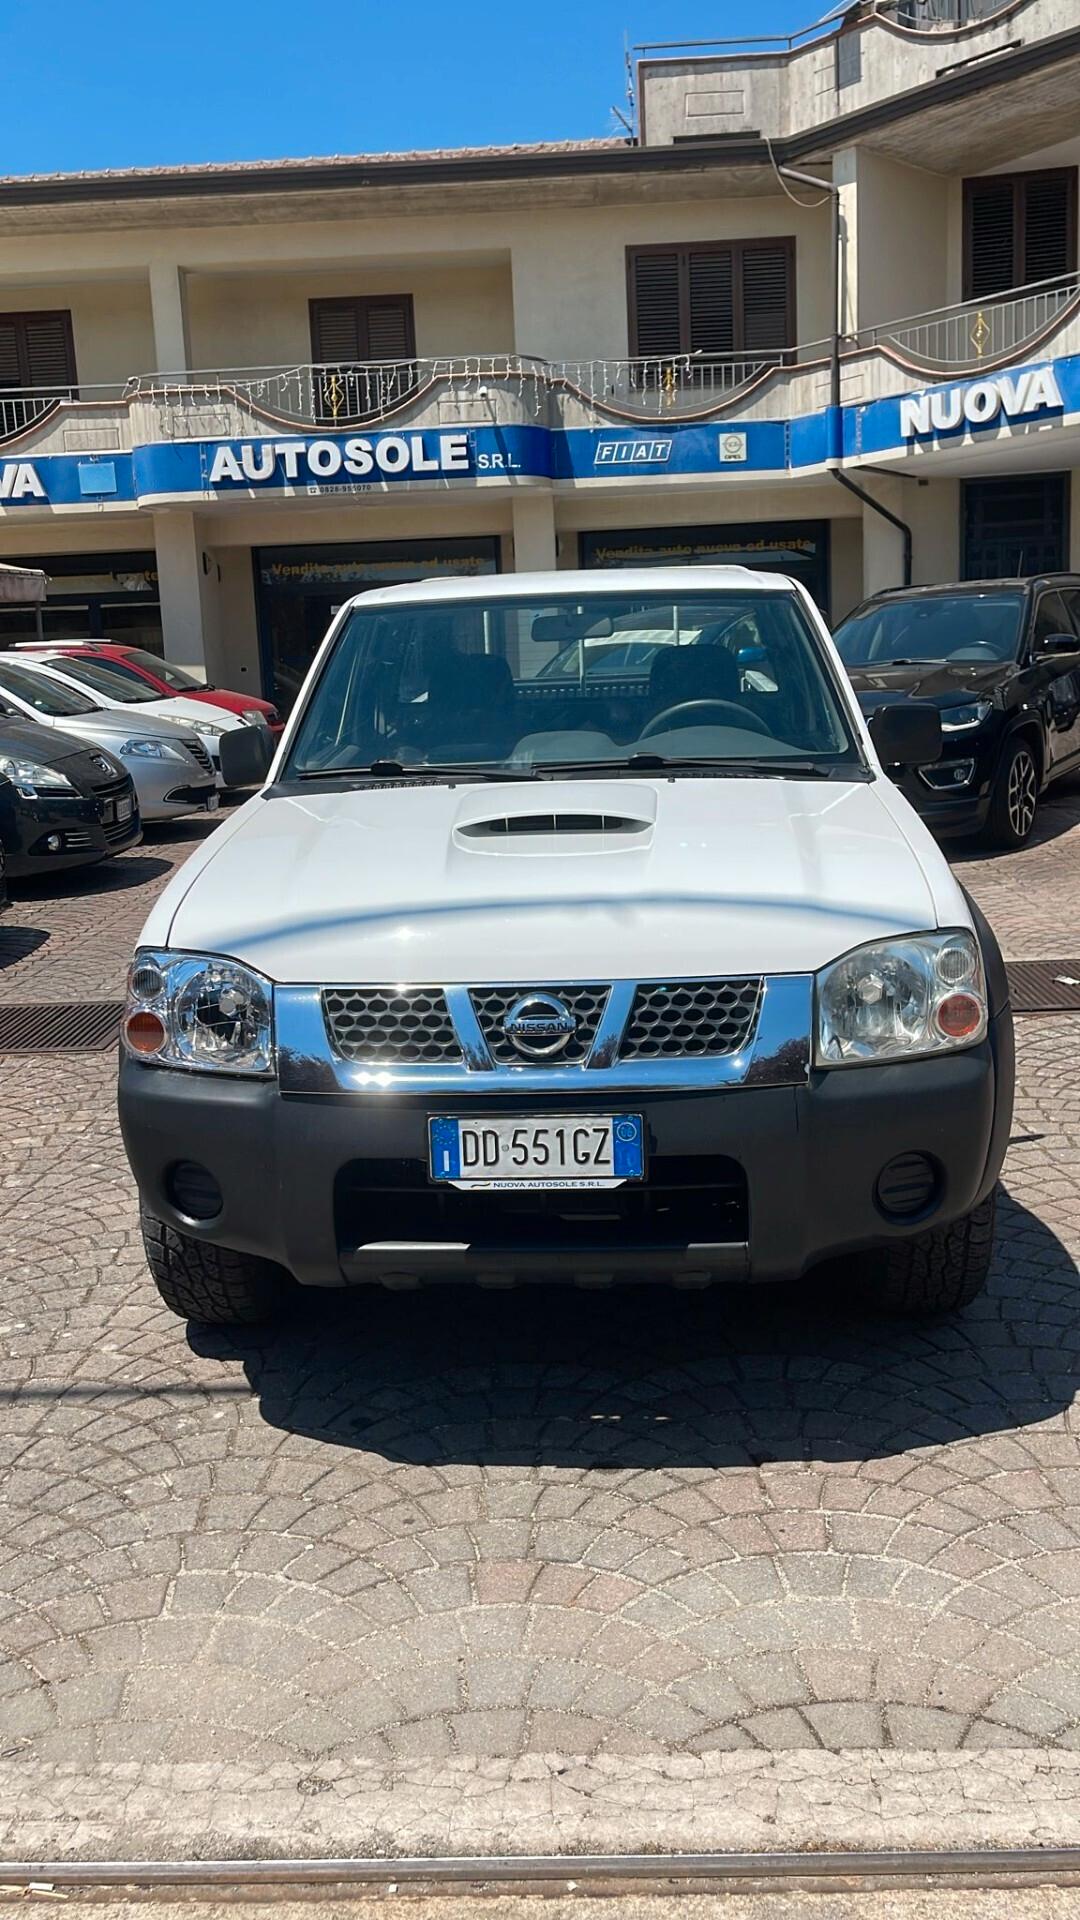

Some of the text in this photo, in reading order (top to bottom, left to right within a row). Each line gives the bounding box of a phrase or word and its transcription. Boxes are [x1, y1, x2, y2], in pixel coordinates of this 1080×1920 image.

[900, 365, 1064, 437] NUOVA
[209, 435, 521, 482] AUTOSOLE S.R.L.
[599, 443, 668, 461] FIAT
[510, 1022, 568, 1033] NISSAN
